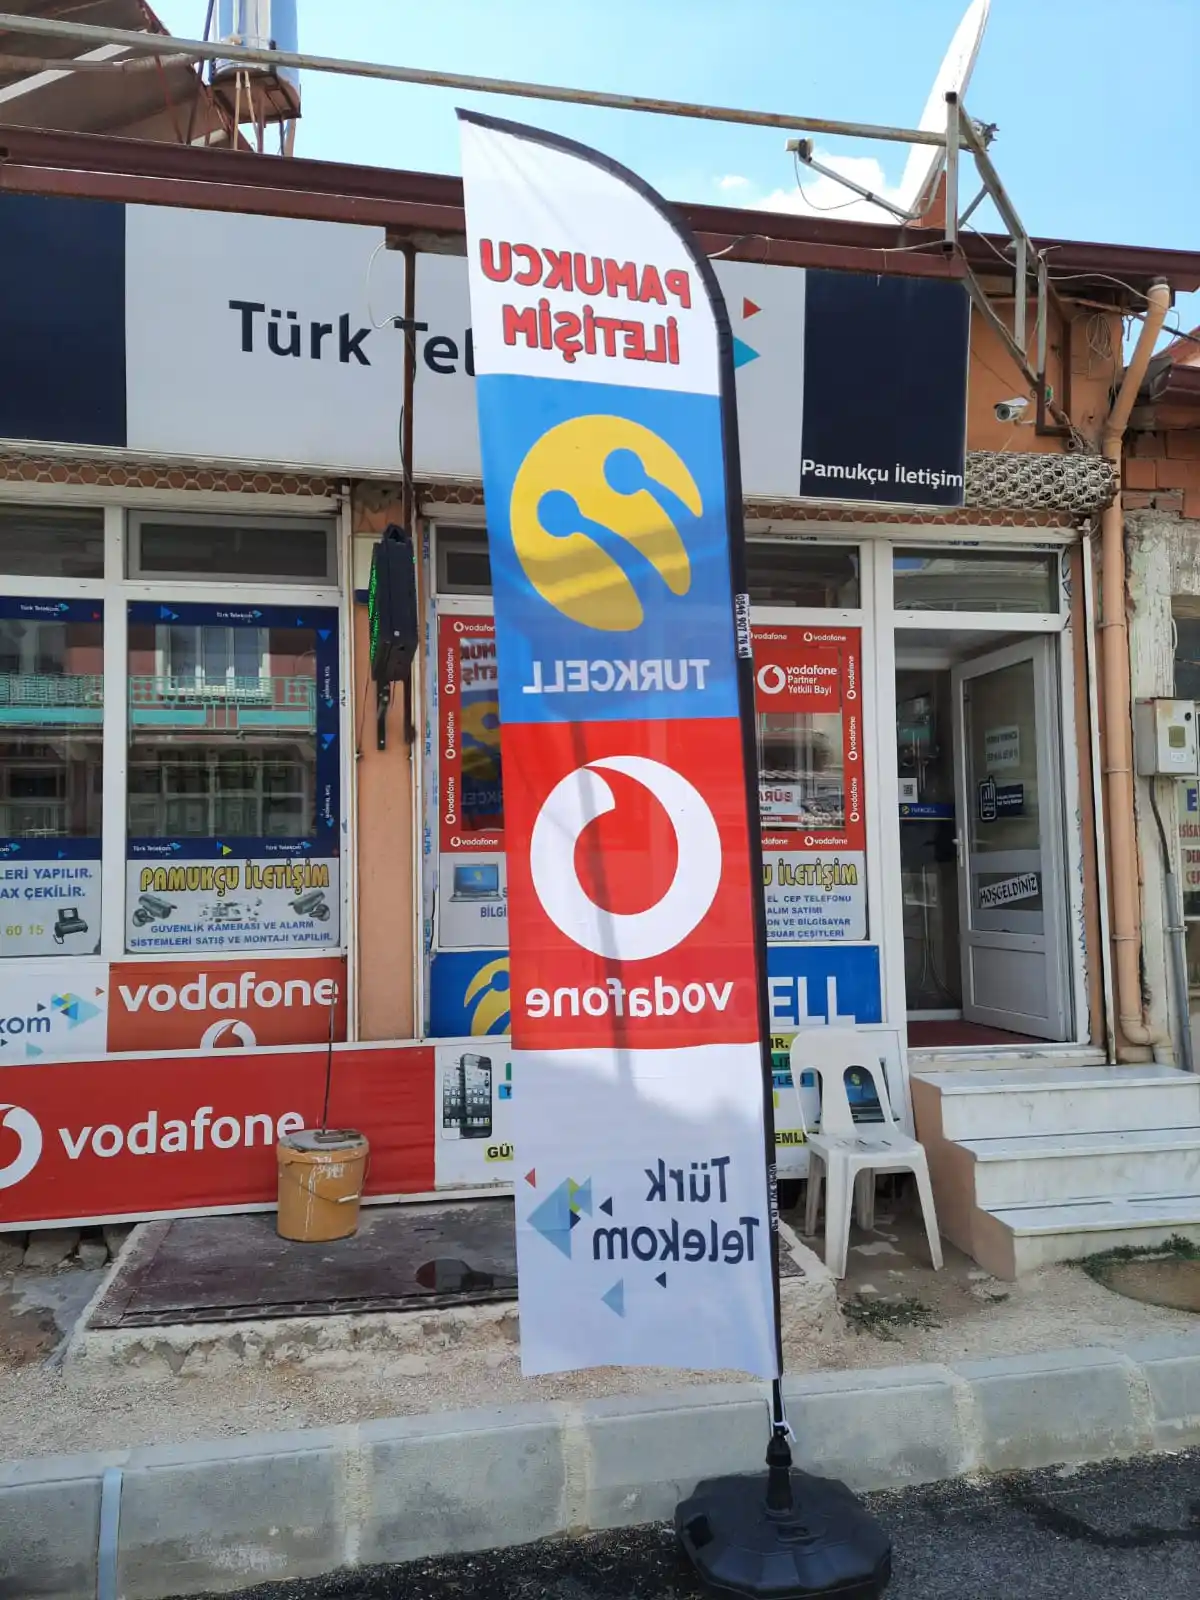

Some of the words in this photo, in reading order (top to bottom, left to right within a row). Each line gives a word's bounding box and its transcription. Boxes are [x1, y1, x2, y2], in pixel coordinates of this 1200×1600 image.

[228, 300, 372, 366] Türk
[801, 459, 889, 485] Pamukçu
[895, 463, 963, 490] İletişim
[754, 632, 787, 640] vodafone
[786, 665, 837, 675] vodafone
[788, 675, 817, 684] Partner
[788, 685, 813, 694] Yetkili
[814, 685, 832, 696] Bayi
[461, 837, 498, 846] vodafone
[814, 836, 848, 845] vodafone
[33, 868, 93, 880] YAPILIR.
[140, 866, 240, 897] PAMUKÇU
[245, 858, 330, 894] İLETİŞİM
[778, 857, 858, 892] İLETİŞİM
[24, 884, 86, 900] ÇEKİLİR.
[980, 872, 1037, 905] HOŞGELDİNİZ
[784, 895, 802, 903] CEP
[803, 894, 852, 903] TELEFONU
[791, 906, 822, 914] SATIMI
[207, 922, 260, 932] KAMERASI
[264, 921, 277, 930] VE
[279, 921, 314, 930] ALARM
[783, 918, 795, 926] VE
[798, 917, 851, 926] BİLGİSAYAR
[131, 936, 192, 947] SİSTEMLERİ
[228, 935, 240, 945] VE
[244, 934, 289, 944] MONTAJI
[119, 972, 339, 1012] vodafone
[58, 1107, 304, 1160] vodafone
